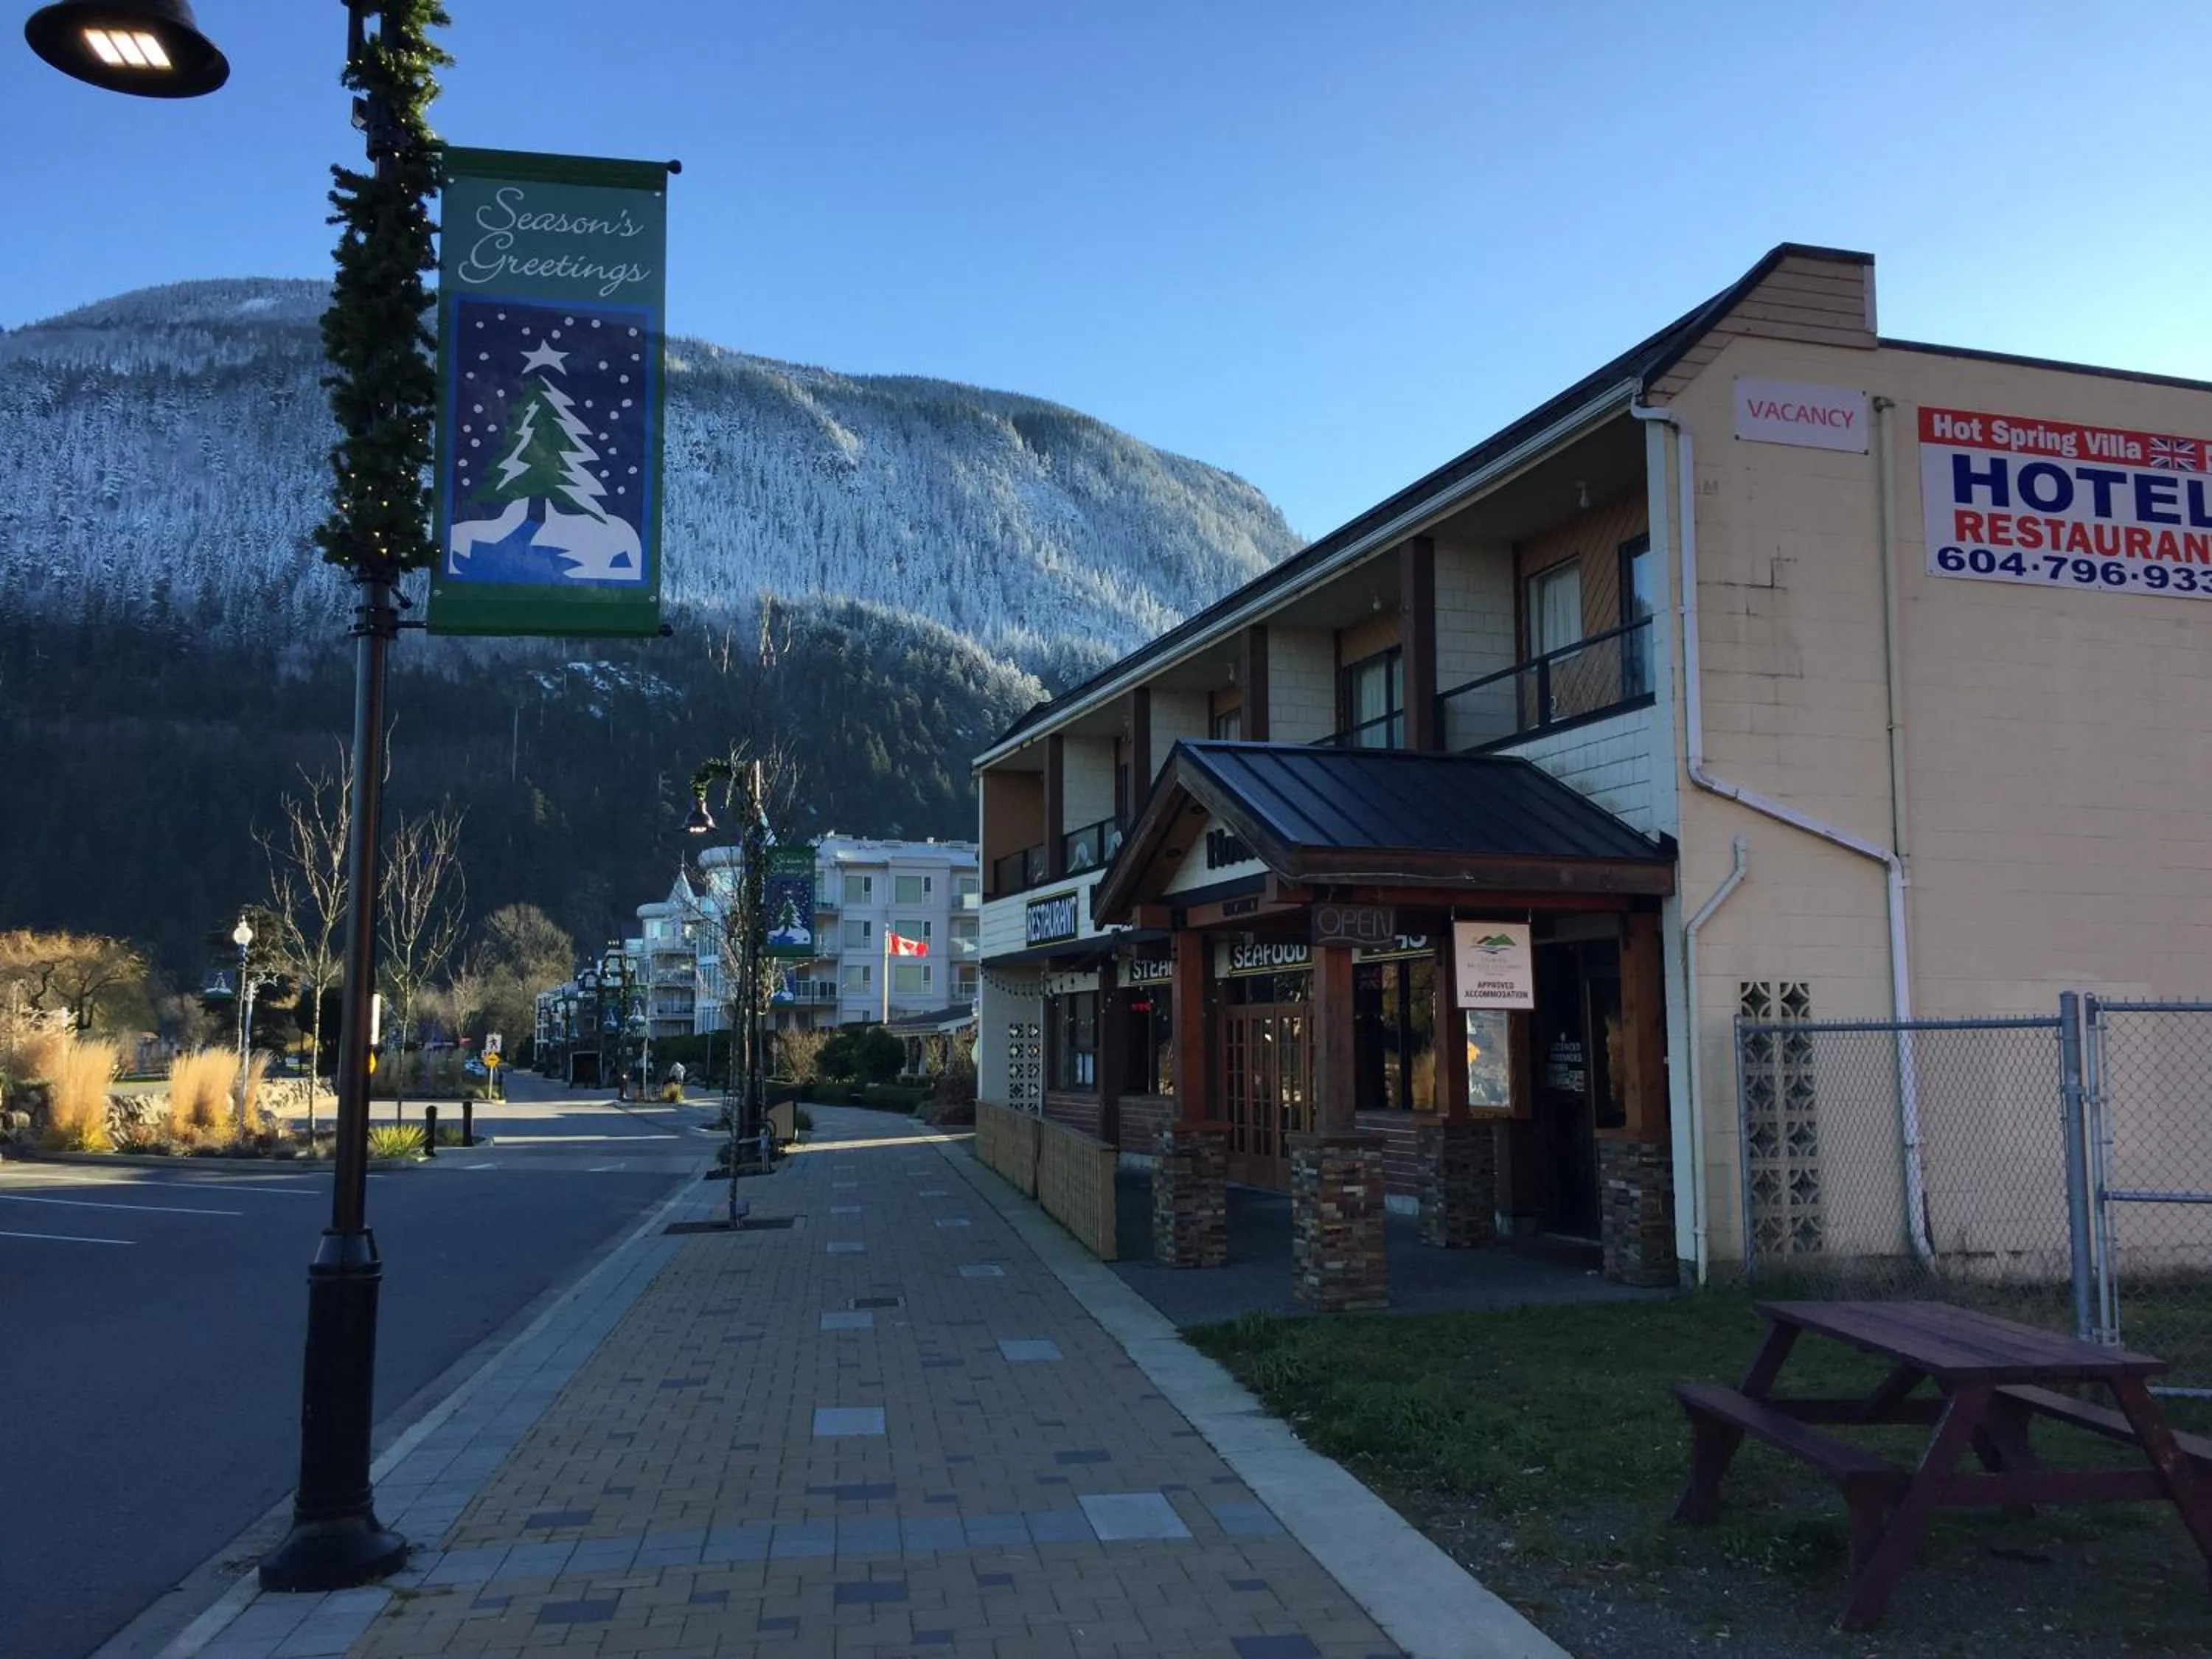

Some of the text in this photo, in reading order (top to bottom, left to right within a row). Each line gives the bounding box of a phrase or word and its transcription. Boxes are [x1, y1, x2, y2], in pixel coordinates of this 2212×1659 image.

[476, 187, 644, 237] Season's
[458, 231, 652, 297] Greetings
[1747, 399, 1854, 428] VACANCY
[1933, 413, 2142, 459] Hot Spring Villa
[1952, 453, 2212, 528] HOTEL
[1955, 509, 2212, 566] RESTAURAN
[1027, 896, 1077, 942] RESTAURANT
[1317, 907, 1394, 939] OPEN
[1133, 960, 1172, 979] STEA
[1234, 943, 1307, 968] SEAFOOD
